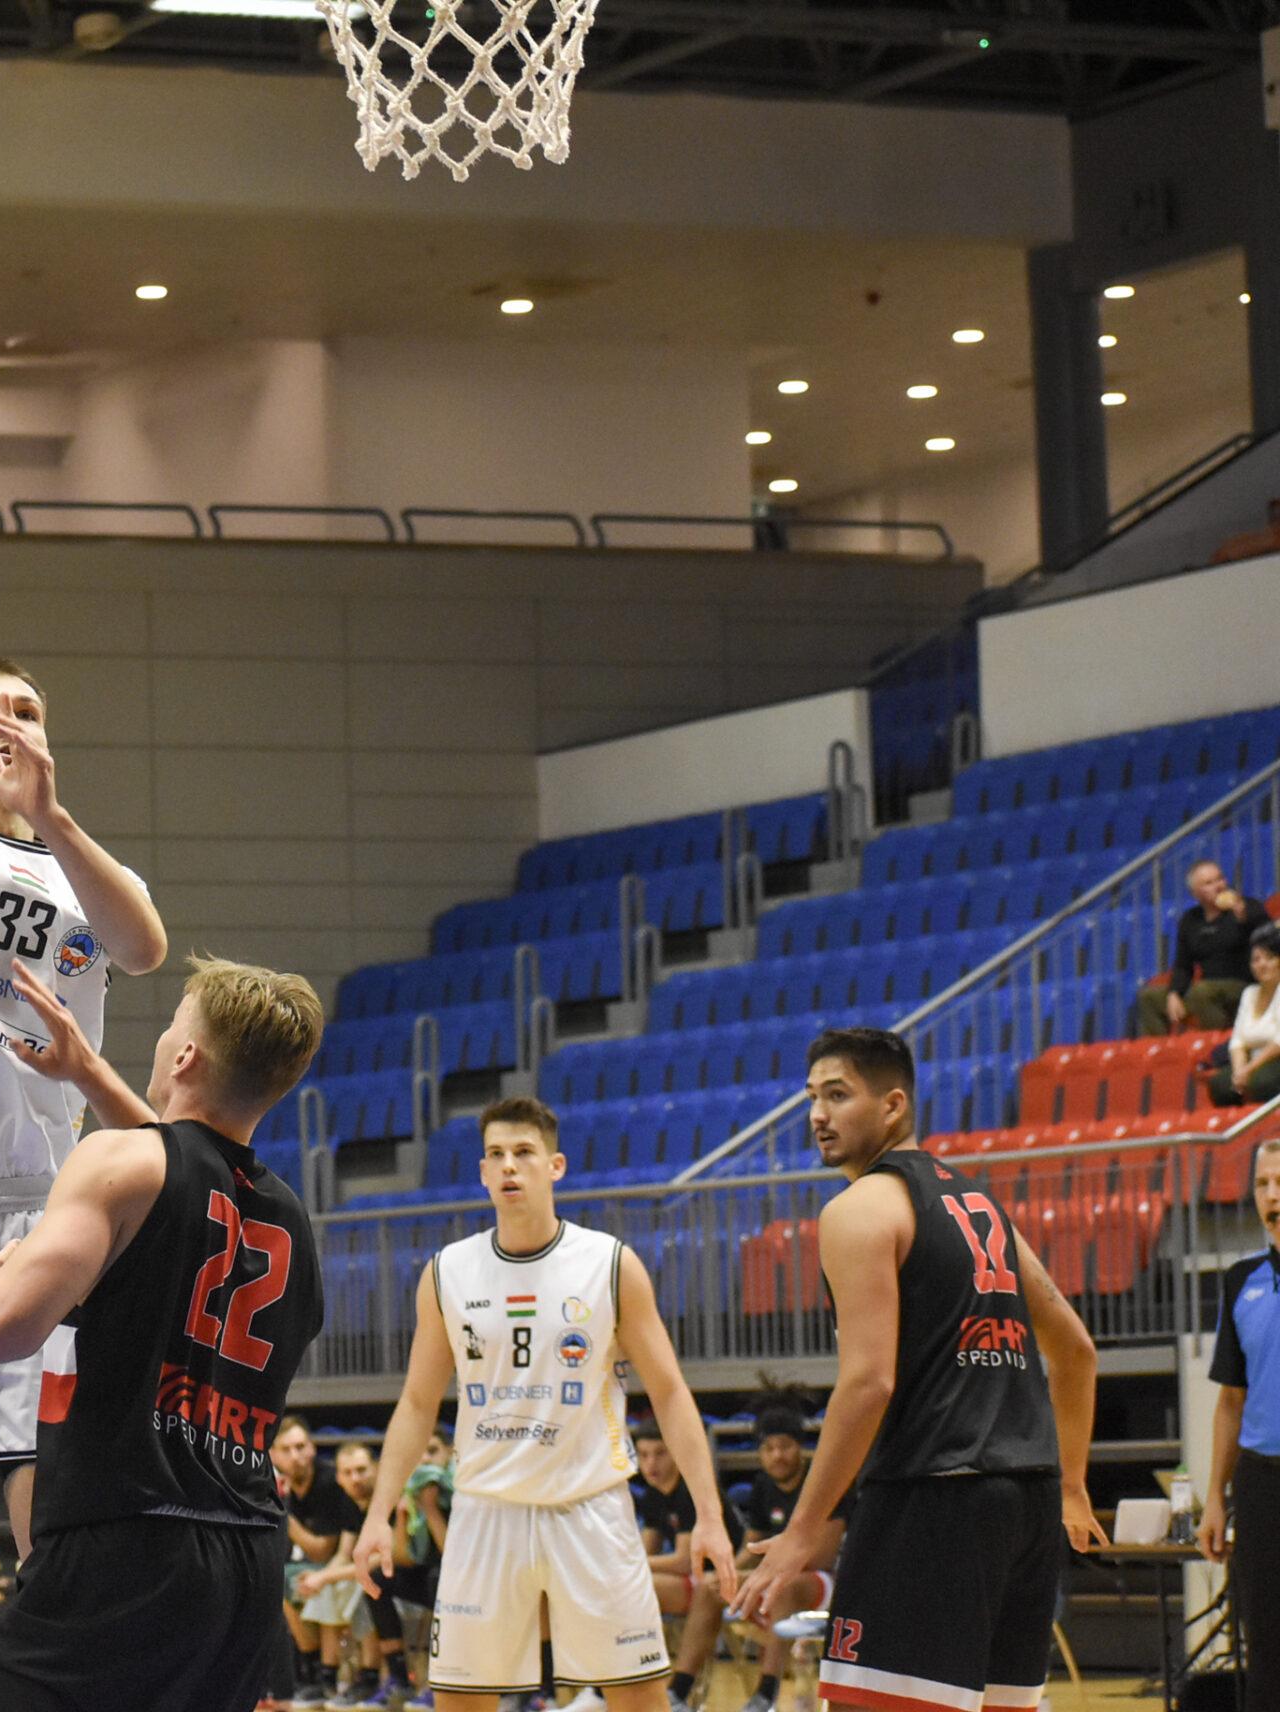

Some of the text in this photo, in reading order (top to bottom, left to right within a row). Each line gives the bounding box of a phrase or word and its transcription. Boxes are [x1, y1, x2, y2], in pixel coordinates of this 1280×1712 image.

[184, 1189, 292, 1372] 22
[465, 1300, 491, 1310] JAKO
[512, 1326, 532, 1368] 8
[431, 1617, 440, 1658] 8
[828, 1616, 863, 1662] 12
